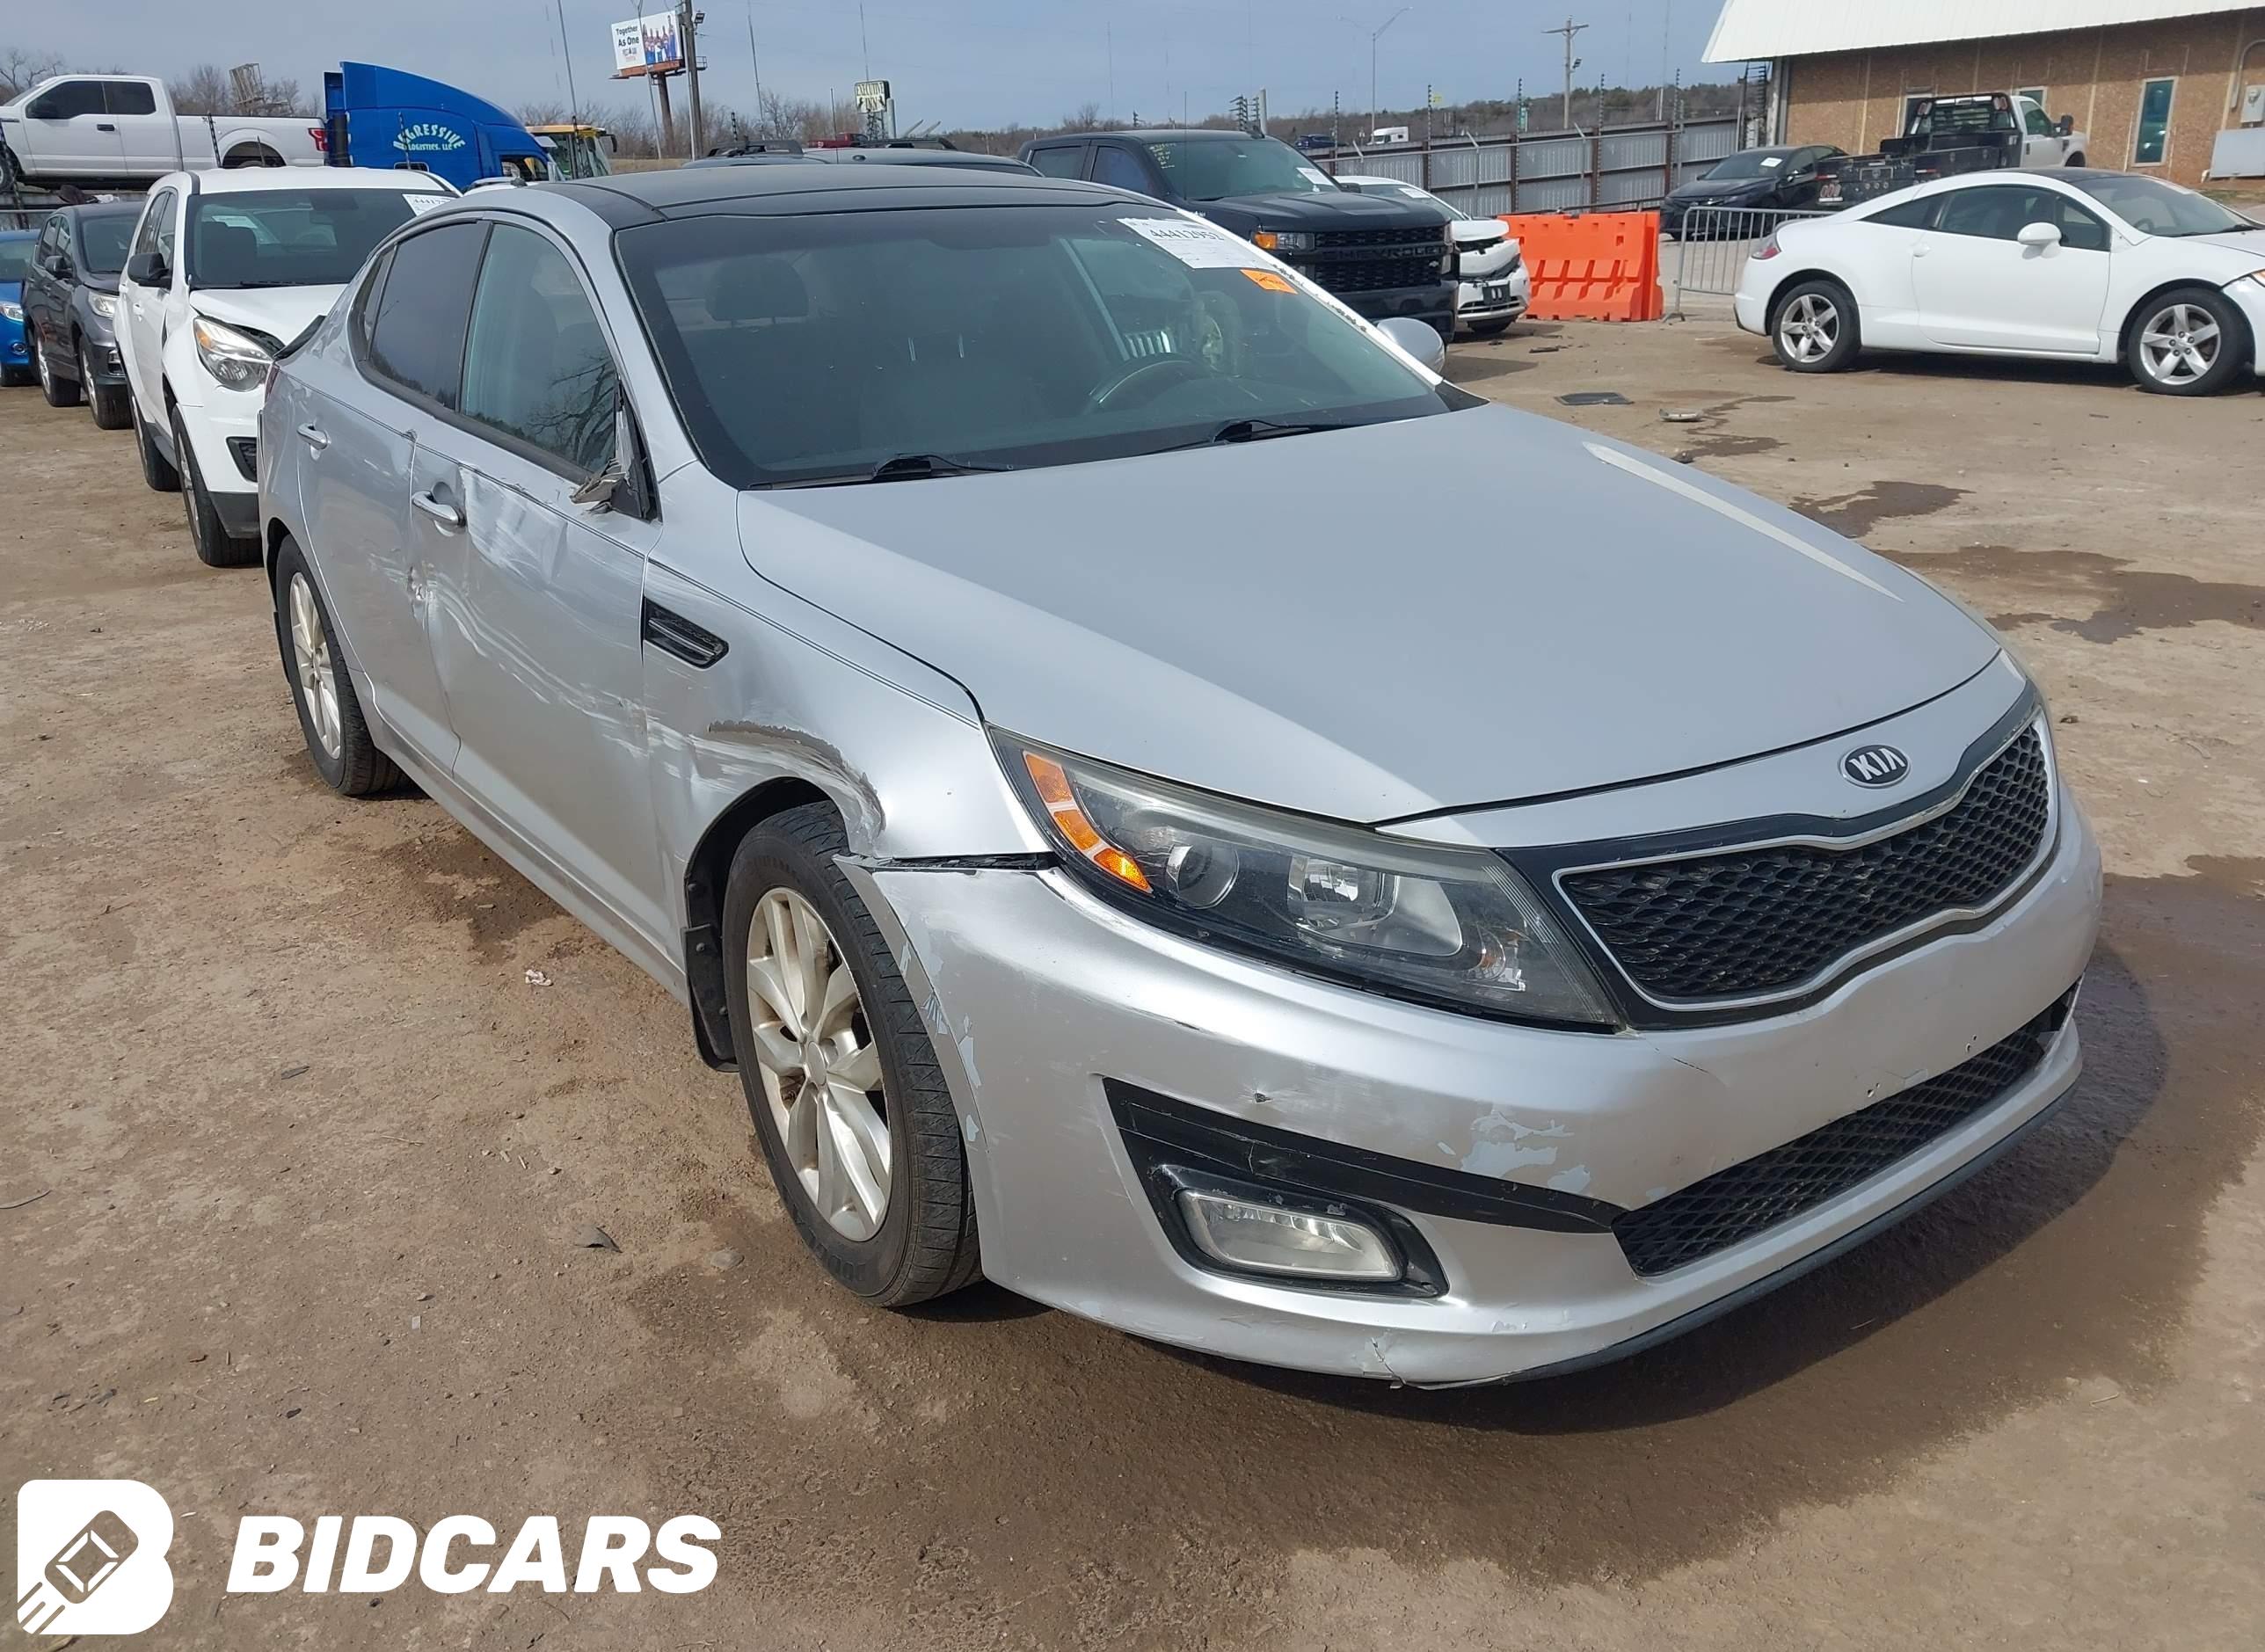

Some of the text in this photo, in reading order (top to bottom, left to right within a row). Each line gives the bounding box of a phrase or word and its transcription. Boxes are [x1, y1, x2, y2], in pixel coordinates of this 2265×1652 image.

[615, 25, 638, 36] Together
[618, 36, 639, 47] As One
[856, 83, 885, 96] EXECUTIVE
[865, 97, 878, 111] INN
[1149, 229, 1225, 241] 44412952
[1322, 245, 1443, 261] CHEVROLET
[1848, 747, 1906, 781] KIA
